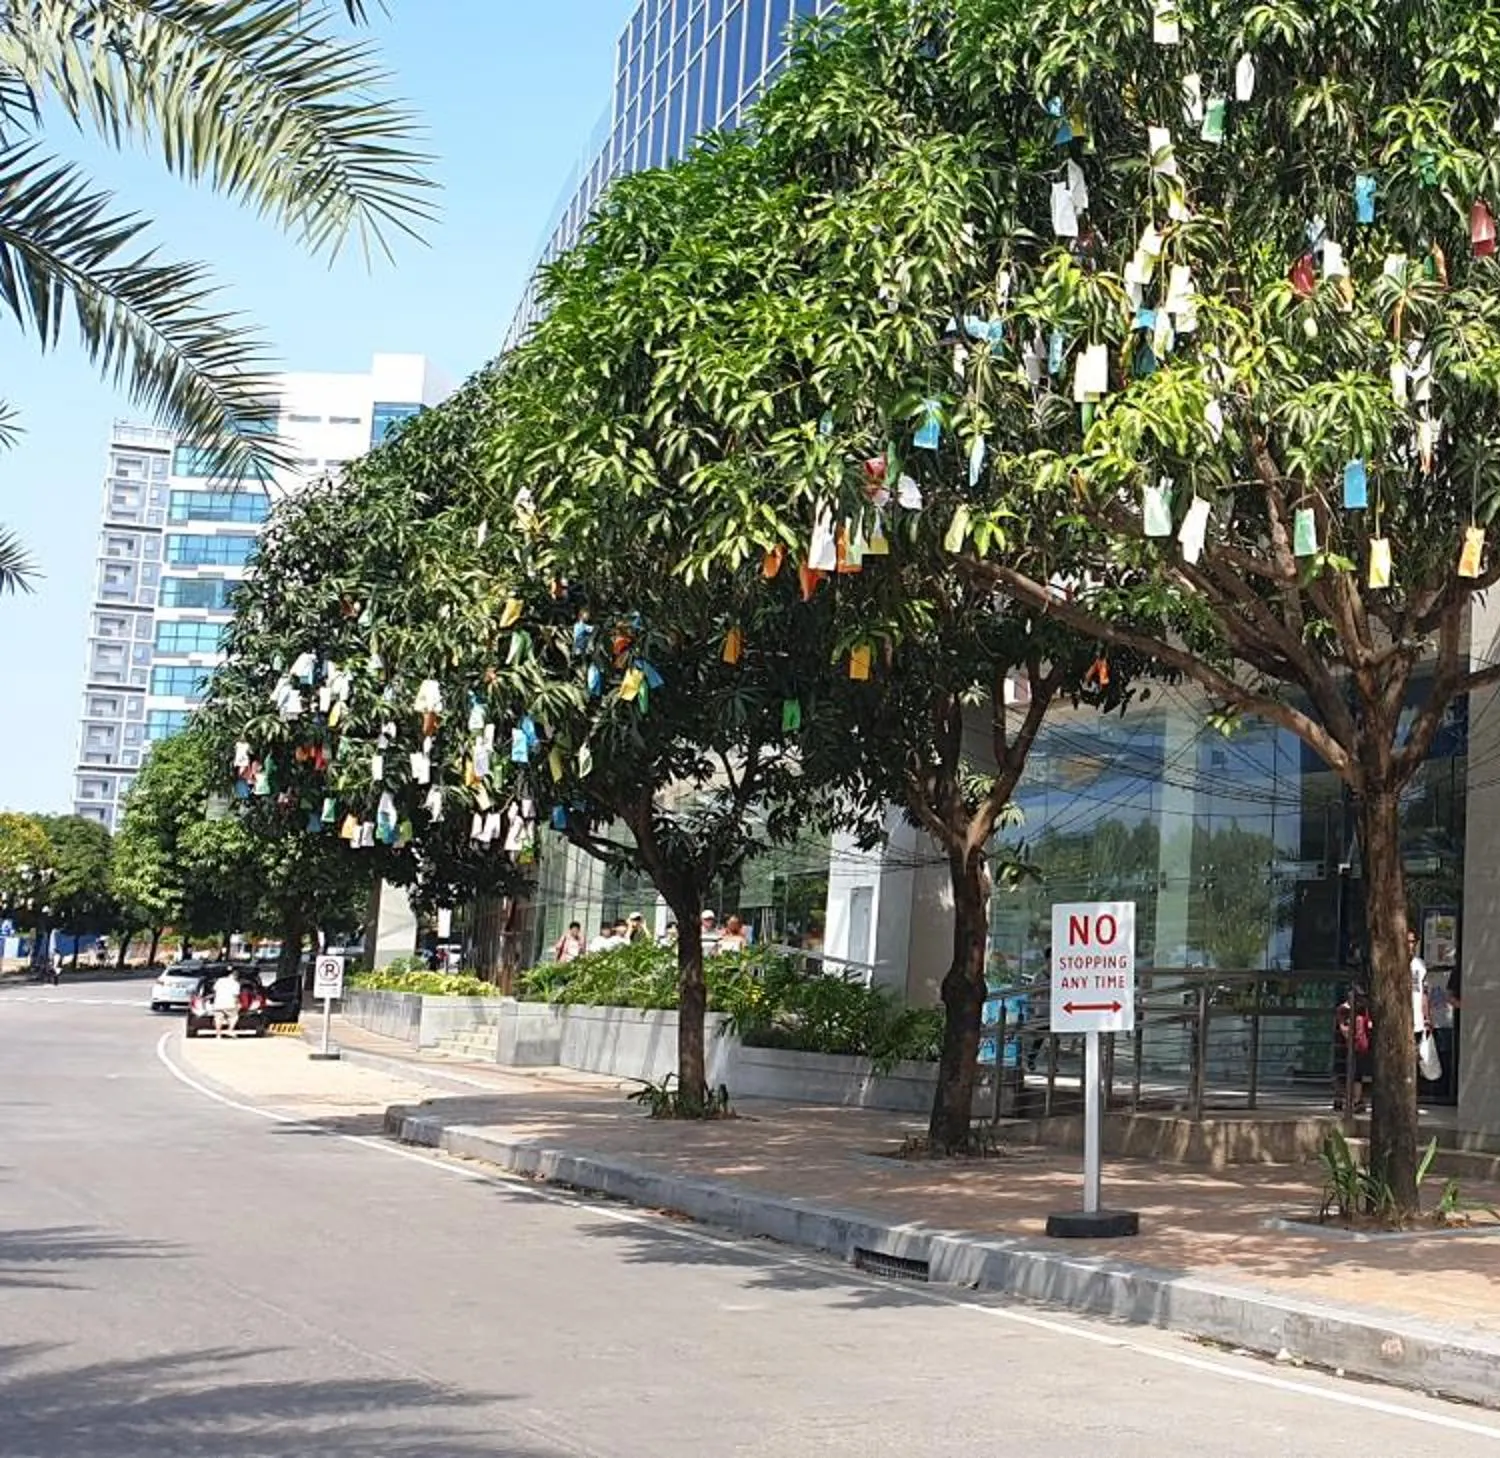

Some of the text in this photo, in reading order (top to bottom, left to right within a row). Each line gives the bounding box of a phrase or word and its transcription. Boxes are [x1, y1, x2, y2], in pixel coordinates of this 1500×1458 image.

[1068, 914, 1117, 946] NO
[1060, 956, 1127, 970] STOPPING
[1061, 975, 1125, 989] ANY TIME
